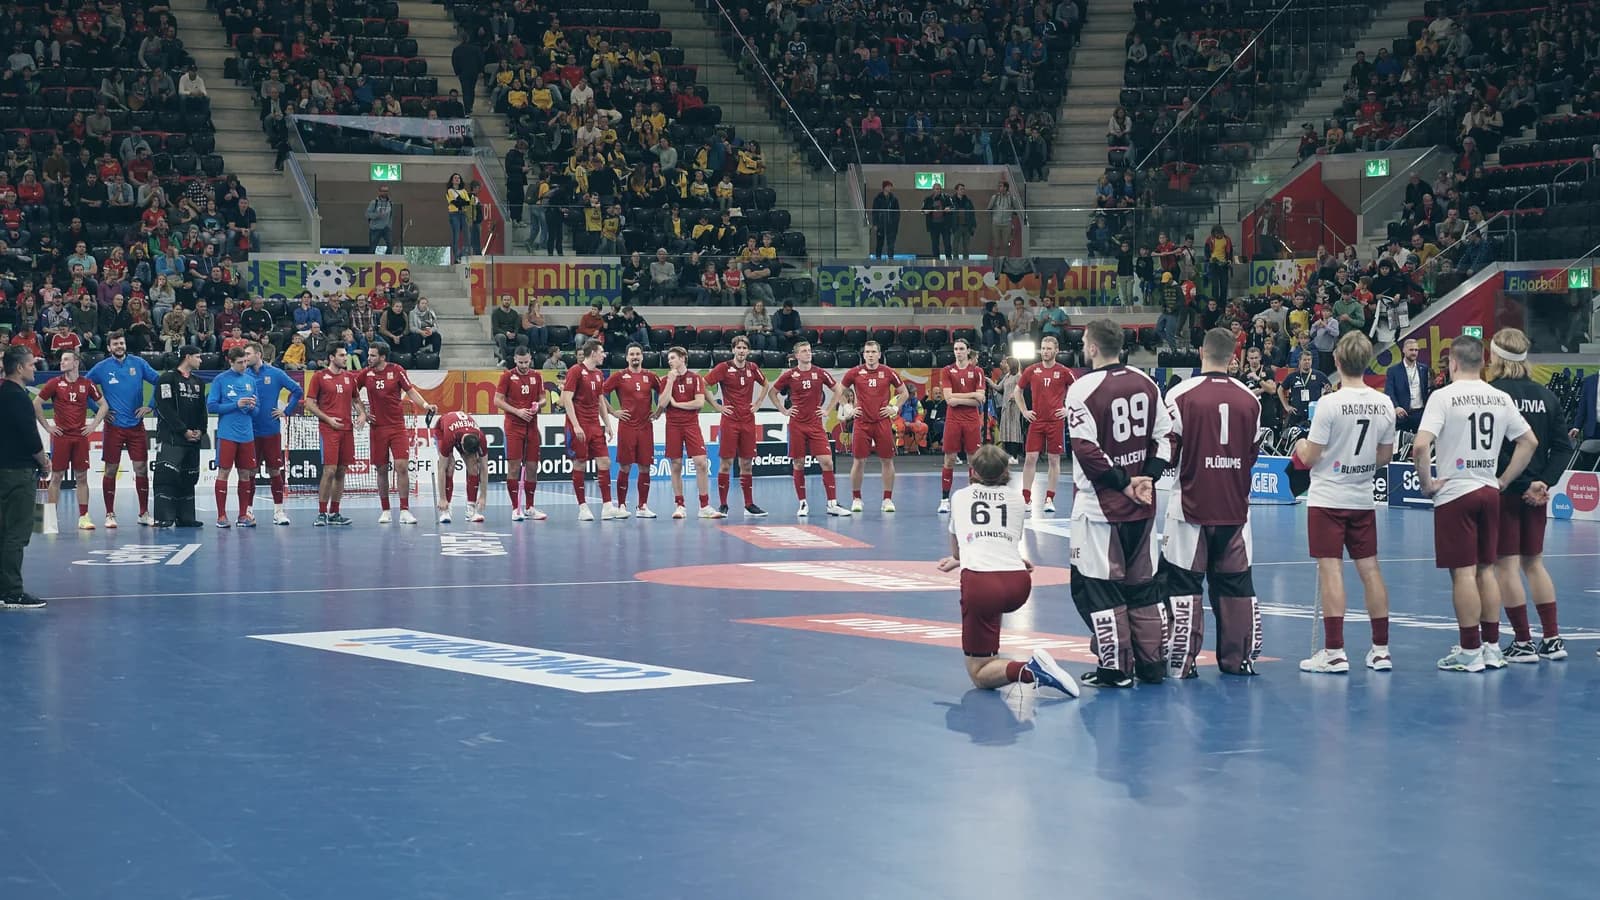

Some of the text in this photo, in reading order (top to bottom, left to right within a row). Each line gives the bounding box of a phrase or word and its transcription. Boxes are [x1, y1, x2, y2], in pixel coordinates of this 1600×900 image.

[1508, 275, 1562, 291] Floorball
[376, 380, 385, 389] 25
[522, 385, 530, 395] 20
[636, 382, 641, 391] 5
[69, 392, 77, 402] 12
[1111, 392, 1149, 443] 89
[1342, 404, 1387, 416] RAGOVSKIS
[1218, 403, 1229, 445] 1
[1468, 412, 1494, 450] 19
[1356, 419, 1370, 456] 7
[1205, 455, 1242, 470] PLŪDUMS
[972, 489, 1005, 501] ŠMITS
[970, 501, 1007, 528] 61
[343, 634, 672, 680] CONCORDIA
